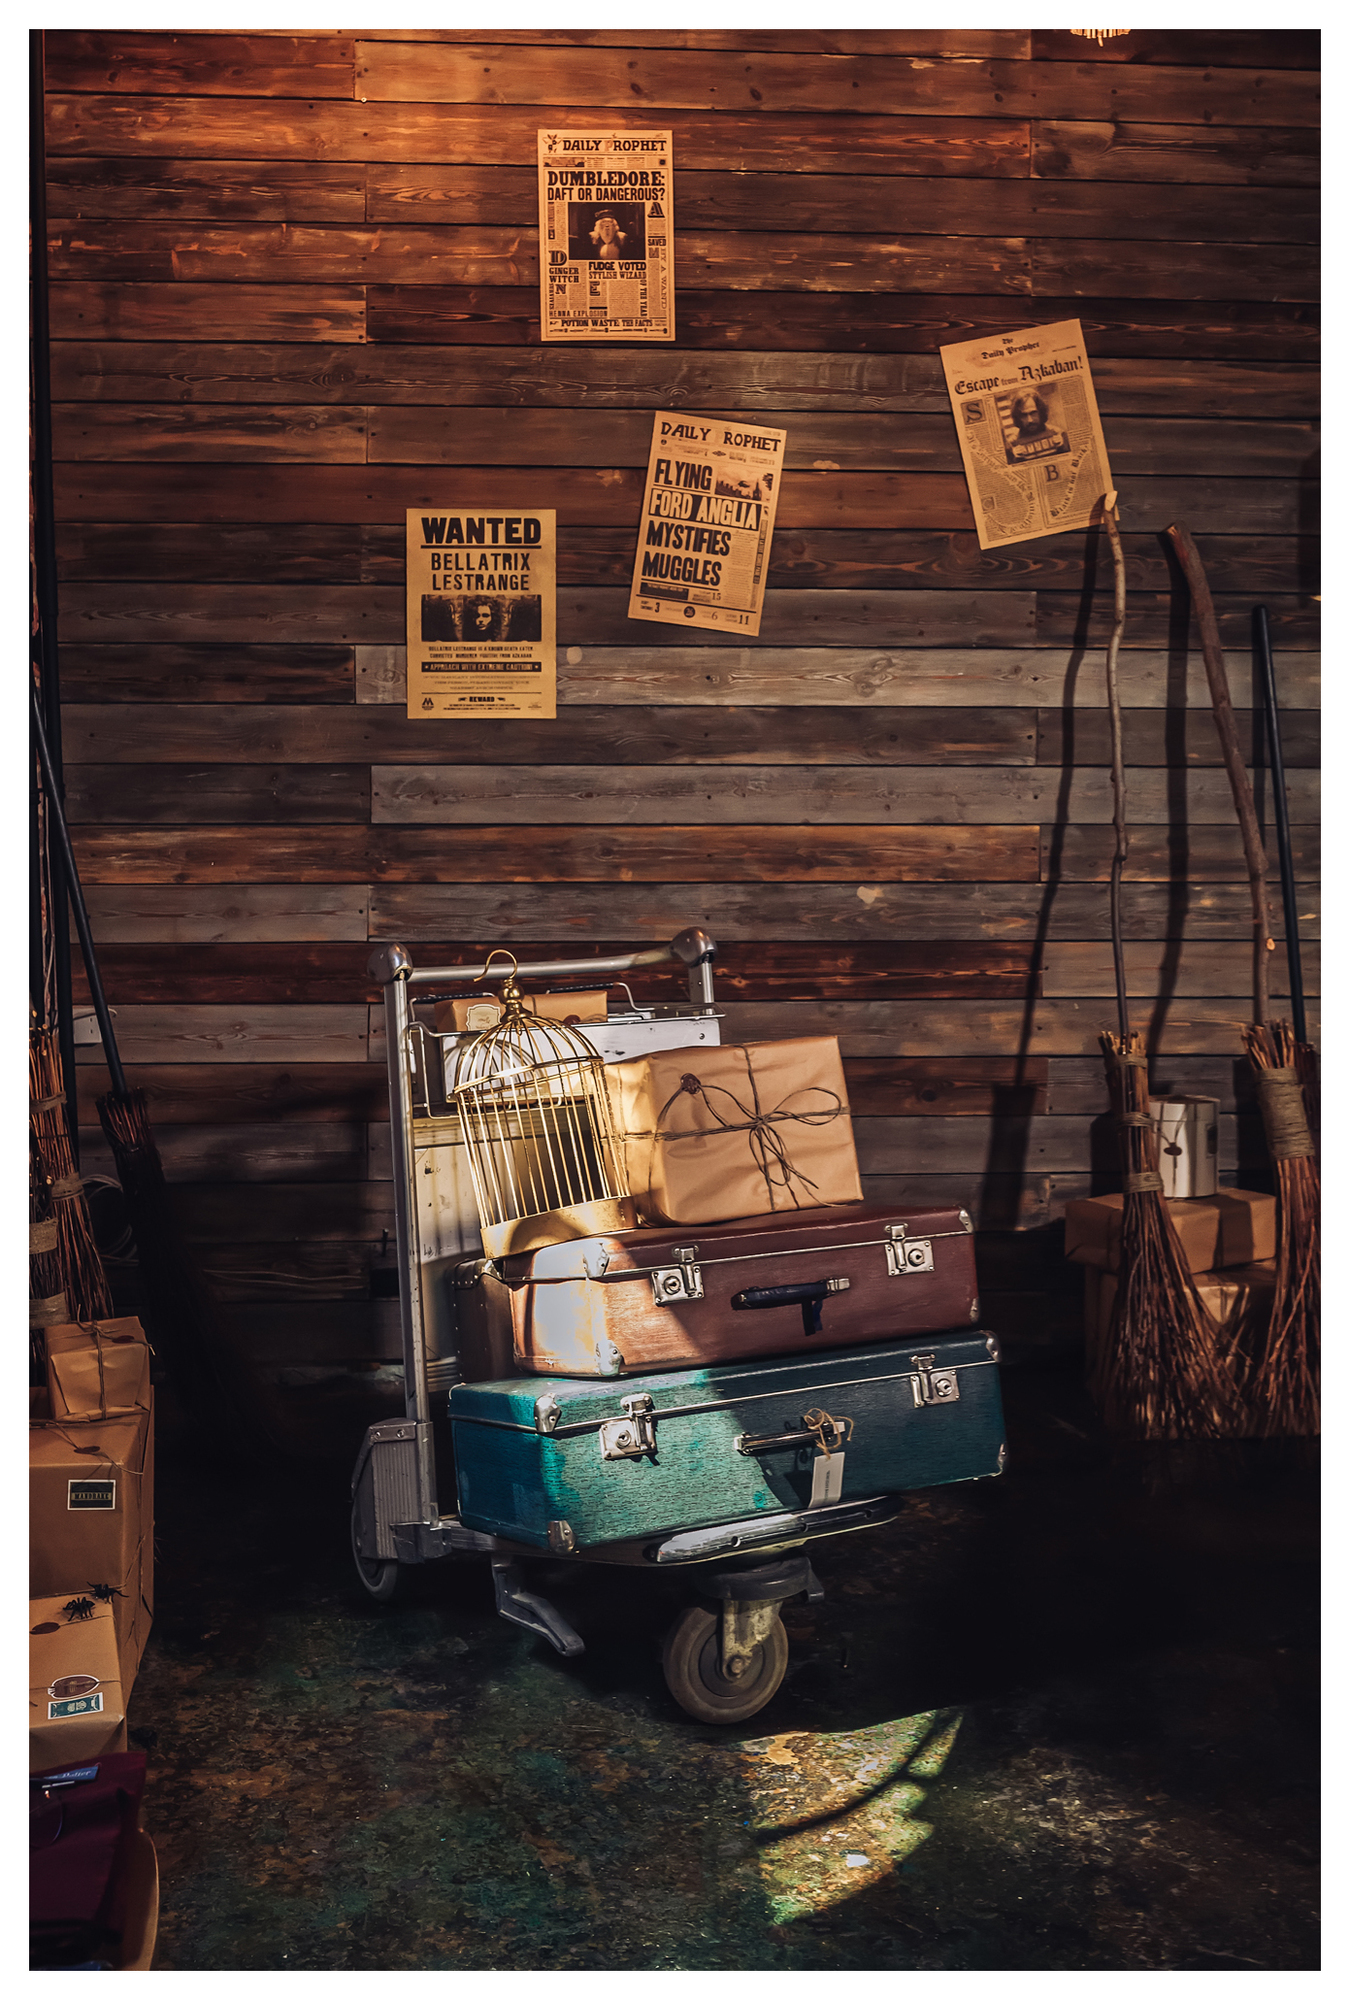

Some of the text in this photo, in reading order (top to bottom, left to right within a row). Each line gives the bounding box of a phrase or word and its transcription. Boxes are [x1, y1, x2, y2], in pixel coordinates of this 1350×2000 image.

[562, 140, 602, 151] DAILY
[548, 171, 665, 186] DUMBLEDORE:
[548, 187, 665, 201] DAFT OR DANGEROUS?
[588, 262, 646, 270] FUDGE VOTED
[620, 271, 647, 279] WIZARD
[981, 350, 1005, 359] Daily
[1006, 341, 1040, 356] Prophet
[954, 356, 1083, 395] Escape from Azkaban!
[661, 422, 711, 441] DAILY
[654, 459, 713, 490] FLYING
[1044, 465, 1059, 482] B
[650, 490, 757, 530] FORD ANGLIA
[421, 517, 541, 544] WANTED
[646, 520, 731, 556] MYSTIFIES
[431, 553, 530, 571] BELLATRIX
[642, 551, 722, 586] MUGGLES
[432, 574, 529, 590] LESTRANGE
[712, 592, 721, 600] 15
[655, 602, 660, 613] 3
[712, 612, 718, 620] 6
[738, 615, 749, 625] 11
